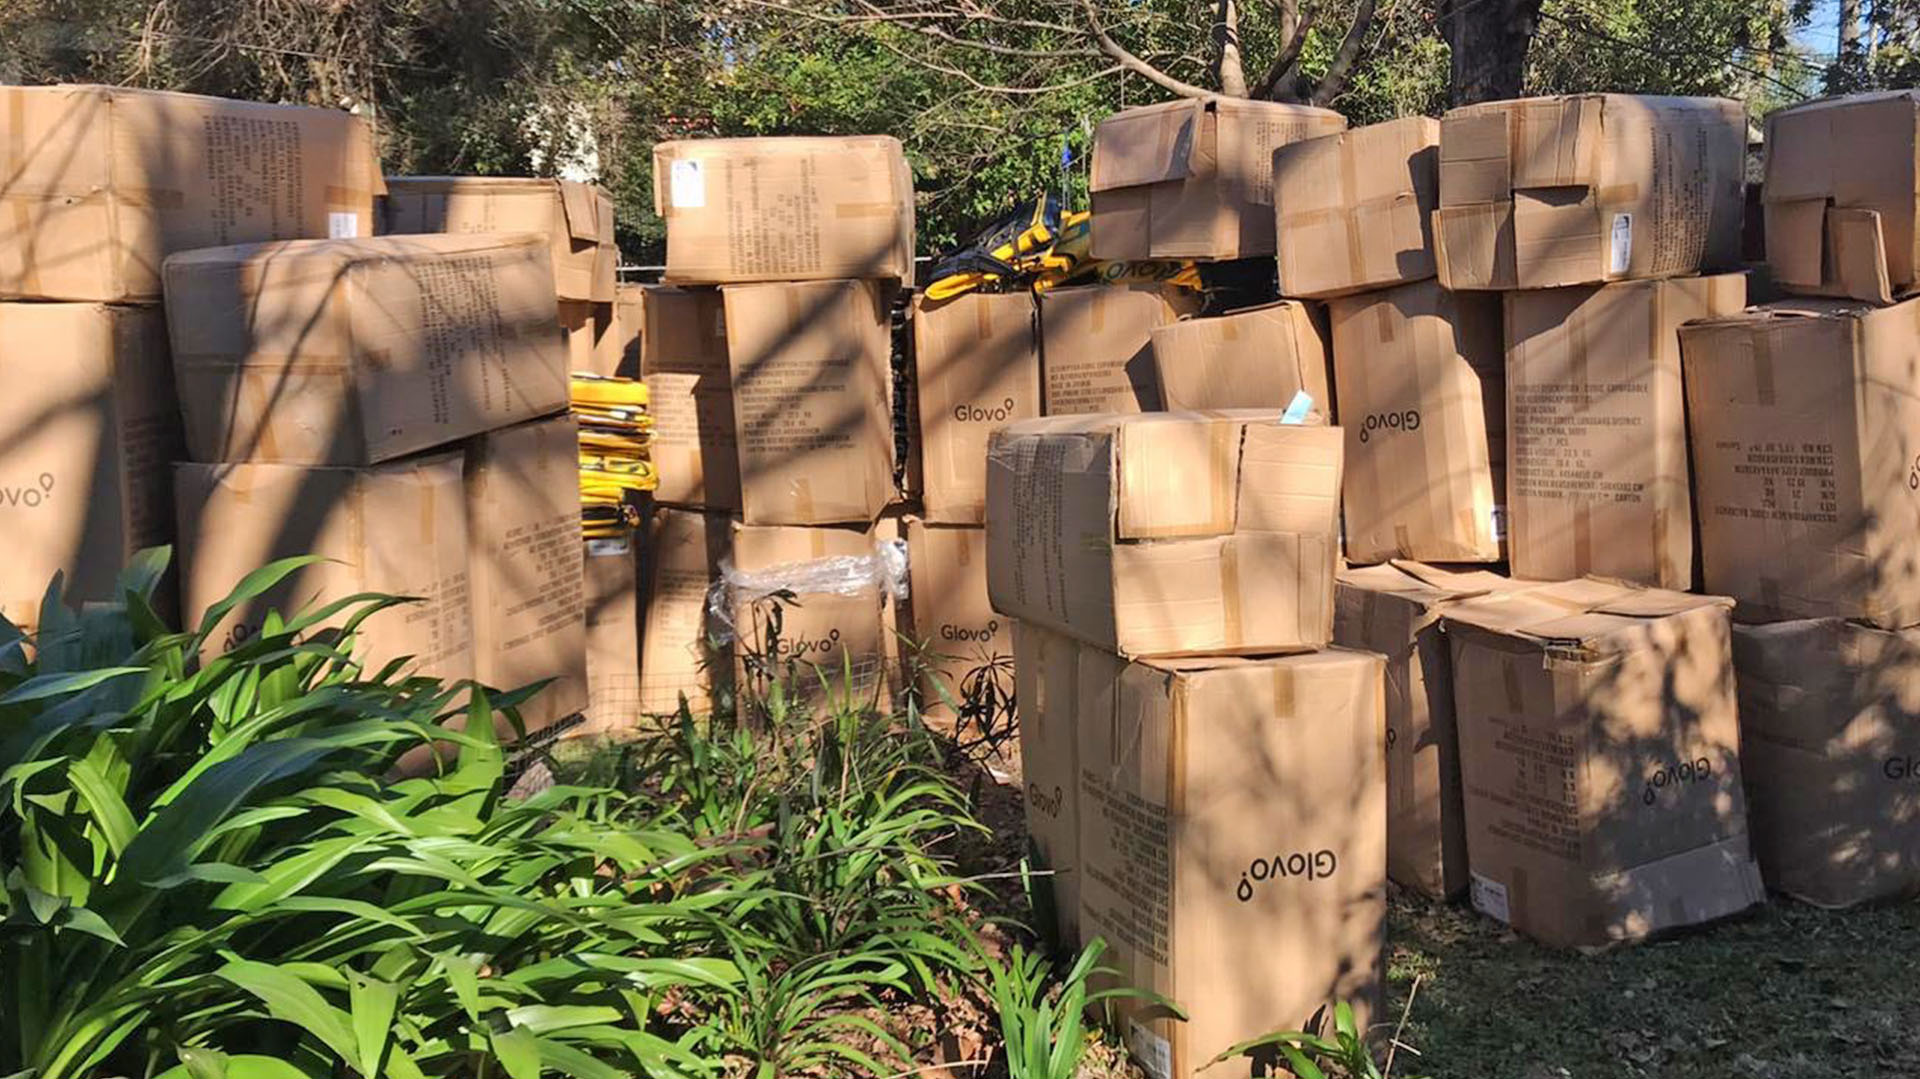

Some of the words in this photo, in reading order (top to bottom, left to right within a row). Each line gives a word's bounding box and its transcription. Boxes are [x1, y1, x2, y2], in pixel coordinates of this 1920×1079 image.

[954, 403, 1007, 421] Glovo
[1365, 410, 1421, 432] Glovo
[940, 623, 991, 642] Glovo
[776, 637, 832, 655] Glovo
[1653, 757, 1712, 789] Glovo
[1250, 849, 1337, 883] Glovo
